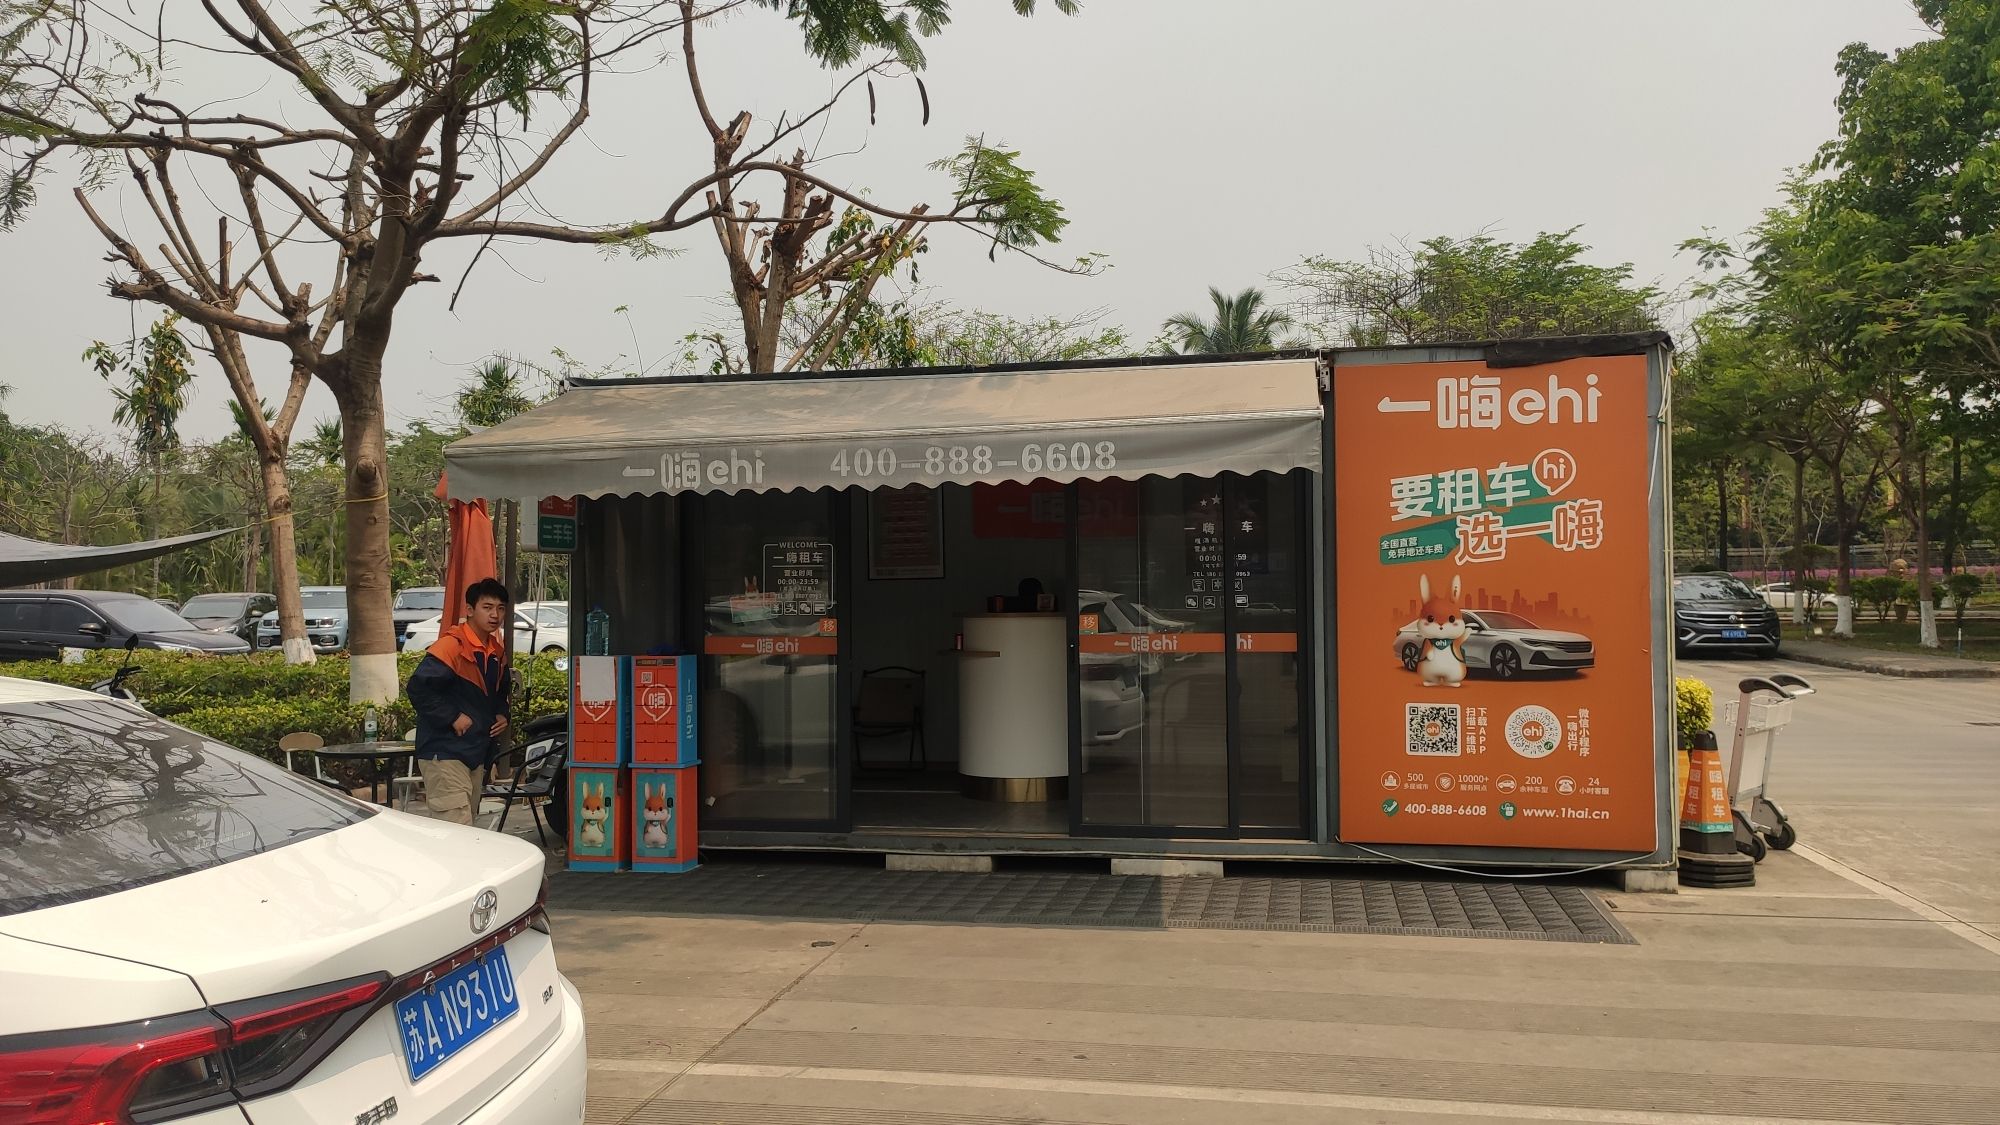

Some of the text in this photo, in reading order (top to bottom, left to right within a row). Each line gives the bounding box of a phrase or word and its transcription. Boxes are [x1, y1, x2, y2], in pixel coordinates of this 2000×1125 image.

[1542, 457, 1566, 480] hi
[1389, 461, 1531, 522] 要租车
[1454, 498, 1604, 566] 选一嗨
[779, 541, 818, 549] WELCOME
[1380, 536, 1418, 550] 全国直营
[772, 551, 824, 564] 一嗨租车
[1387, 543, 1444, 559] 免异地还车费
[783, 569, 813, 577] 营业时间
[1435, 639, 1448, 648] ehi
[1426, 725, 1440, 735] ehi
[1465, 707, 1476, 755] 扫描二维码
[1477, 707, 1488, 755] 下载APP
[1523, 725, 1544, 737] ehi
[1567, 714, 1578, 751] 一嗨出行
[1578, 708, 1590, 757] 微信小程序
[1407, 773, 1424, 782] 500
[1458, 774, 1490, 784] 10000+
[1525, 776, 1543, 785] 200
[1588, 777, 1600, 787] 24
[1460, 784, 1488, 792] 服务网点
[1579, 787, 1610, 796] 小时客服
[1707, 760, 1726, 818] 一嗨租车
[1404, 803, 1487, 816] 400-888-6608
[1522, 806, 1610, 820] www.1hai.cn
[422, 915, 532, 985] ALLION
